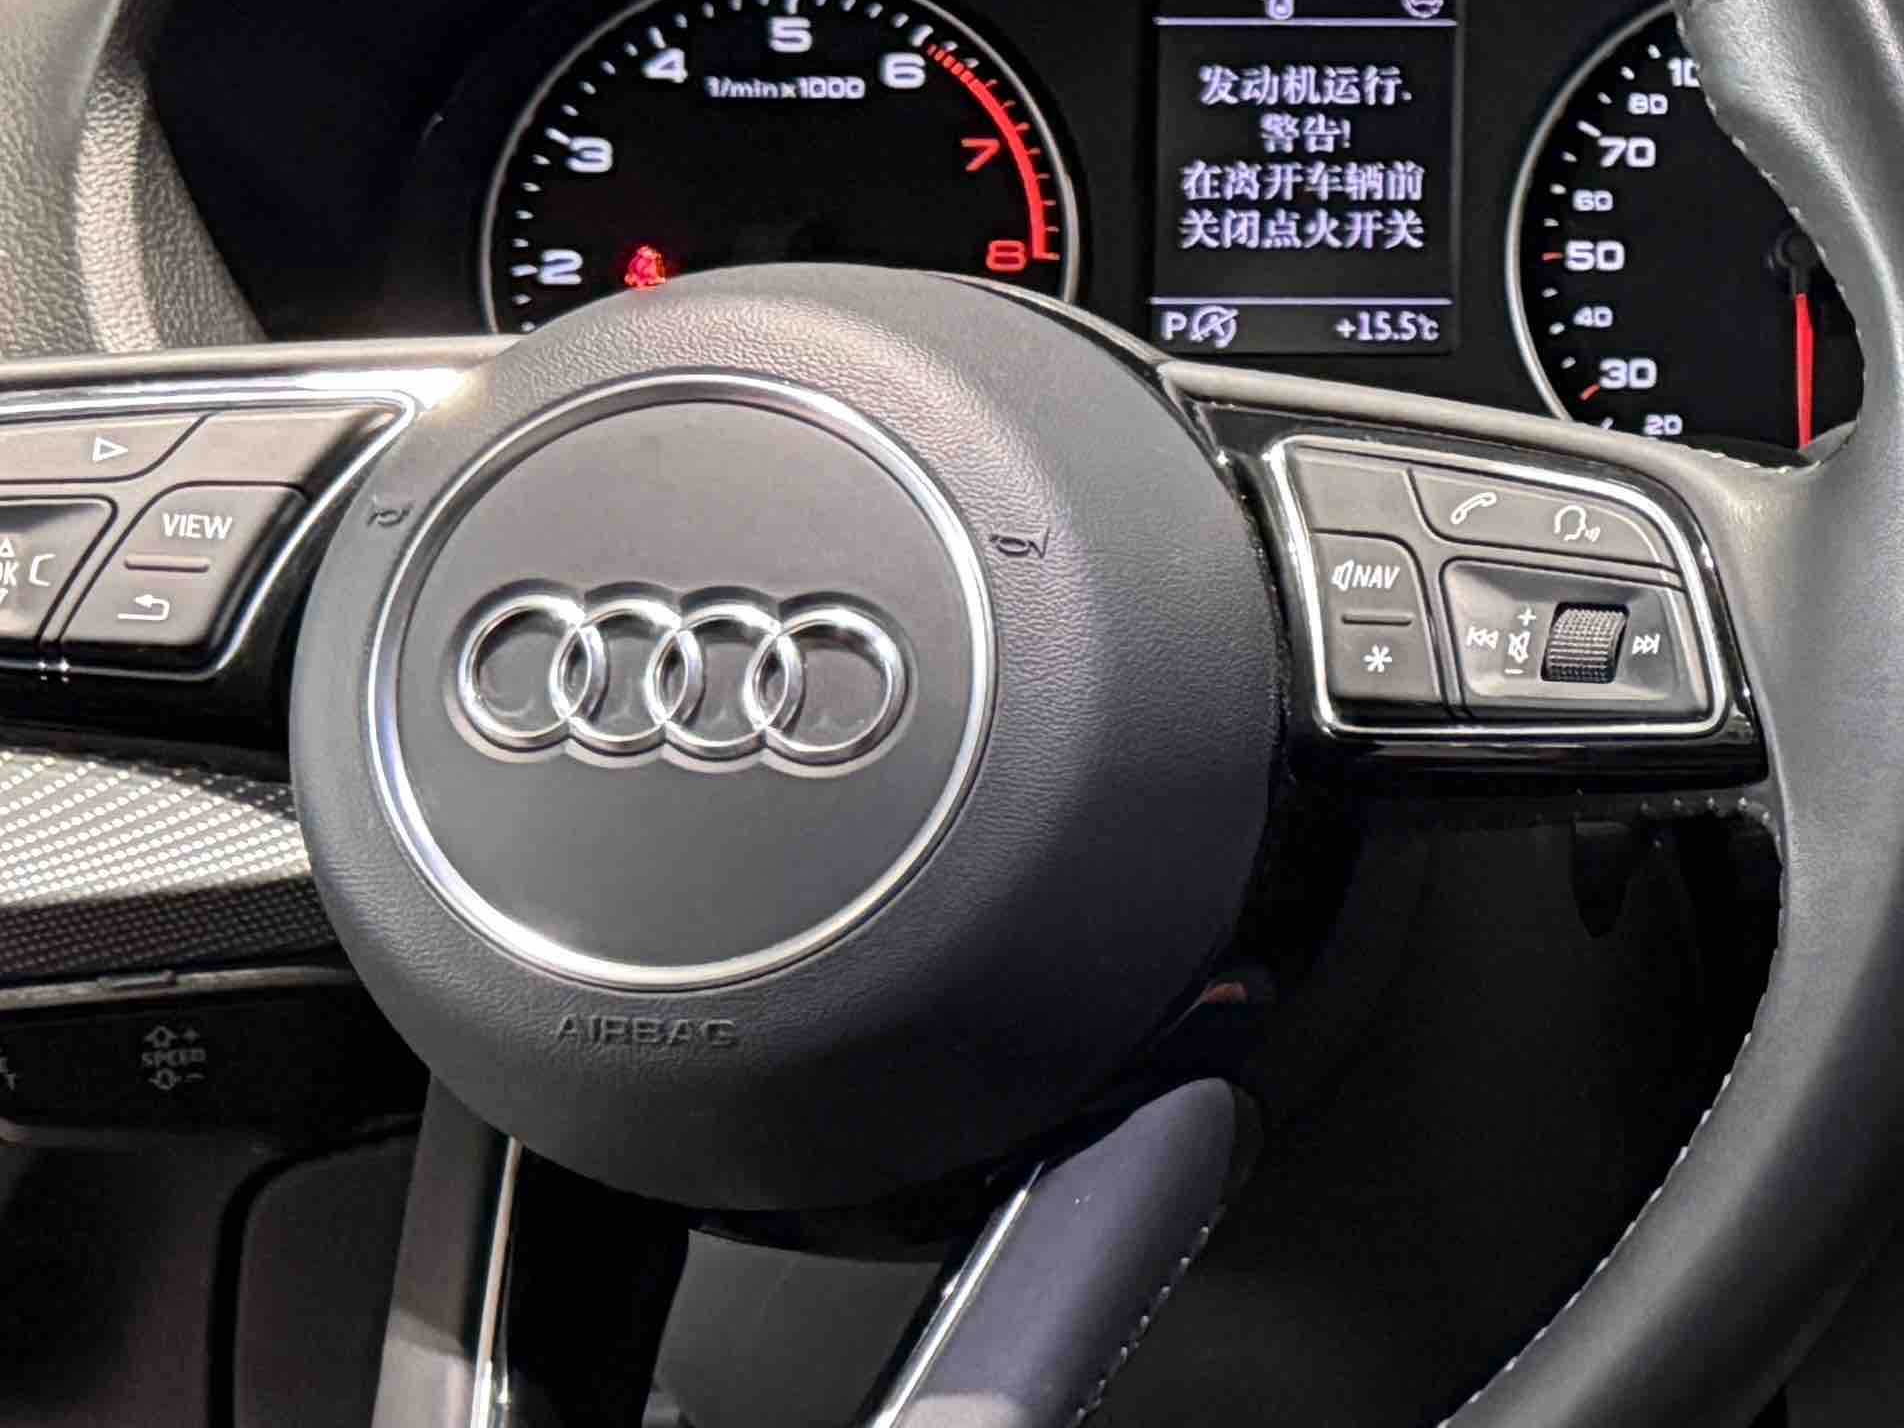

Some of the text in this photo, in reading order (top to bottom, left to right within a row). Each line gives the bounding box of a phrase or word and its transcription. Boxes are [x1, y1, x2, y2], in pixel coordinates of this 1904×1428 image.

[768, 17, 812, 52] 5
[643, 47, 688, 84] 4
[880, 52, 926, 89] 6
[1627, 92, 1668, 116] 80
[1260, 113, 1352, 153] 警告!
[566, 136, 613, 173] 3
[960, 138, 999, 172] 7
[1600, 137, 1655, 168] 70
[1182, 161, 1425, 201] 在离开车辆前
[1573, 190, 1613, 213] 60
[1180, 208, 1425, 249] 关闭点火开关
[537, 249, 584, 285] 2
[985, 239, 1026, 272] 8
[1565, 241, 1625, 271] 50
[1572, 306, 1613, 329] 40
[1599, 357, 1657, 390] 30
[1643, 414, 1683, 437] 20
[162, 512, 233, 539] VIEW
[1351, 563, 1401, 590] NAV
[555, 1013, 739, 1049] AIRBAG
